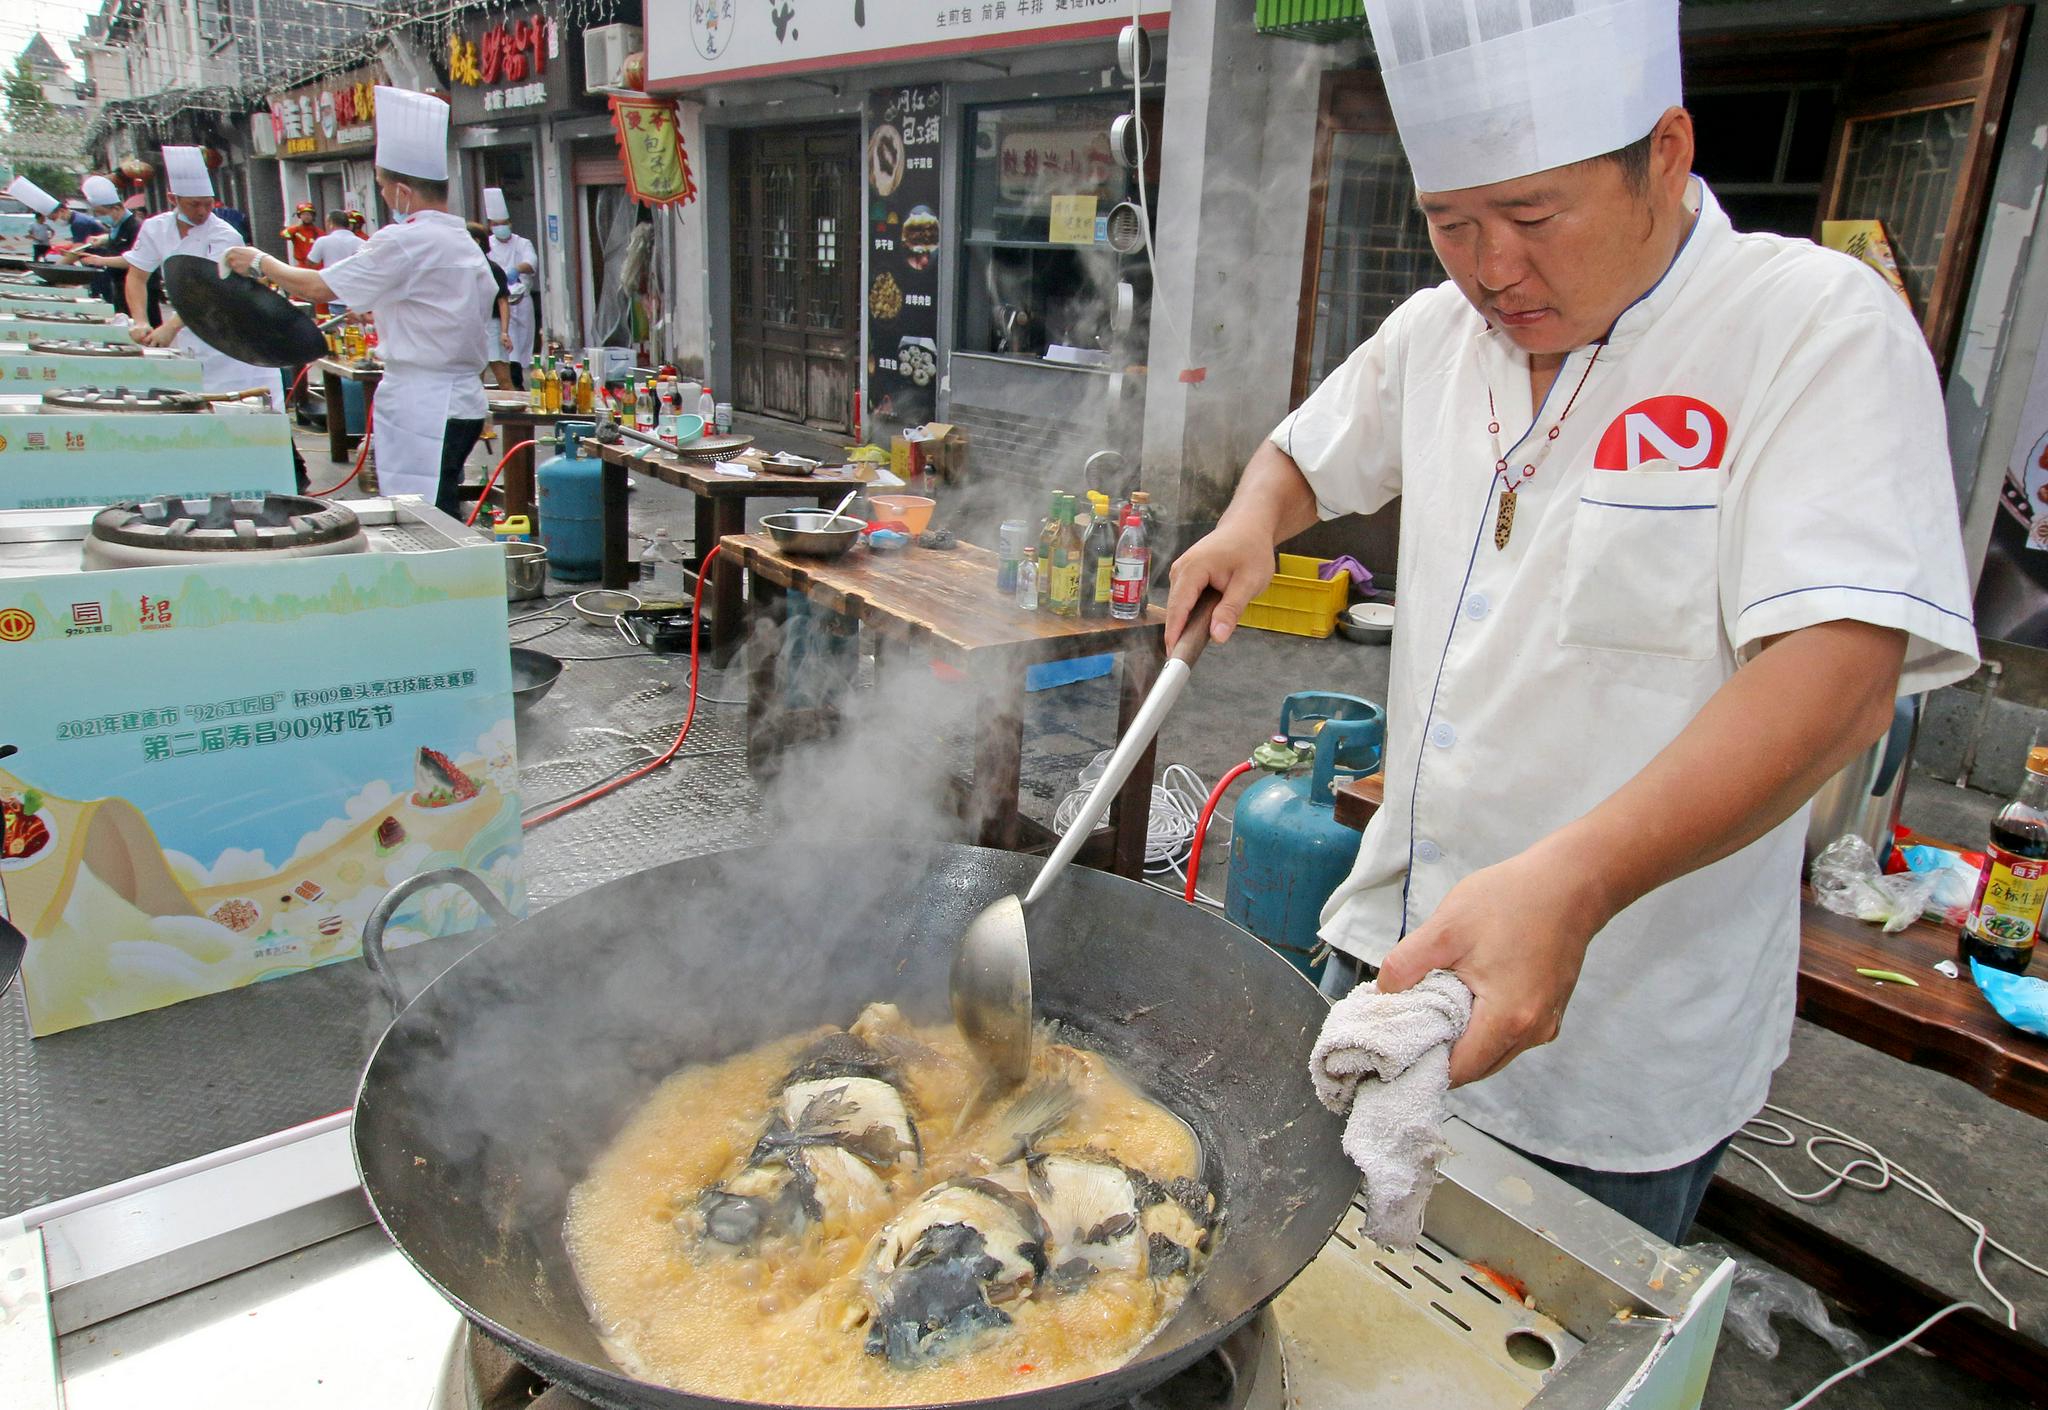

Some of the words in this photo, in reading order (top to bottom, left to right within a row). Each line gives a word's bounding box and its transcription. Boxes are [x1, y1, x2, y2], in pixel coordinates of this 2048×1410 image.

[144, 704, 393, 761] 第二届寿昌909好吃节
